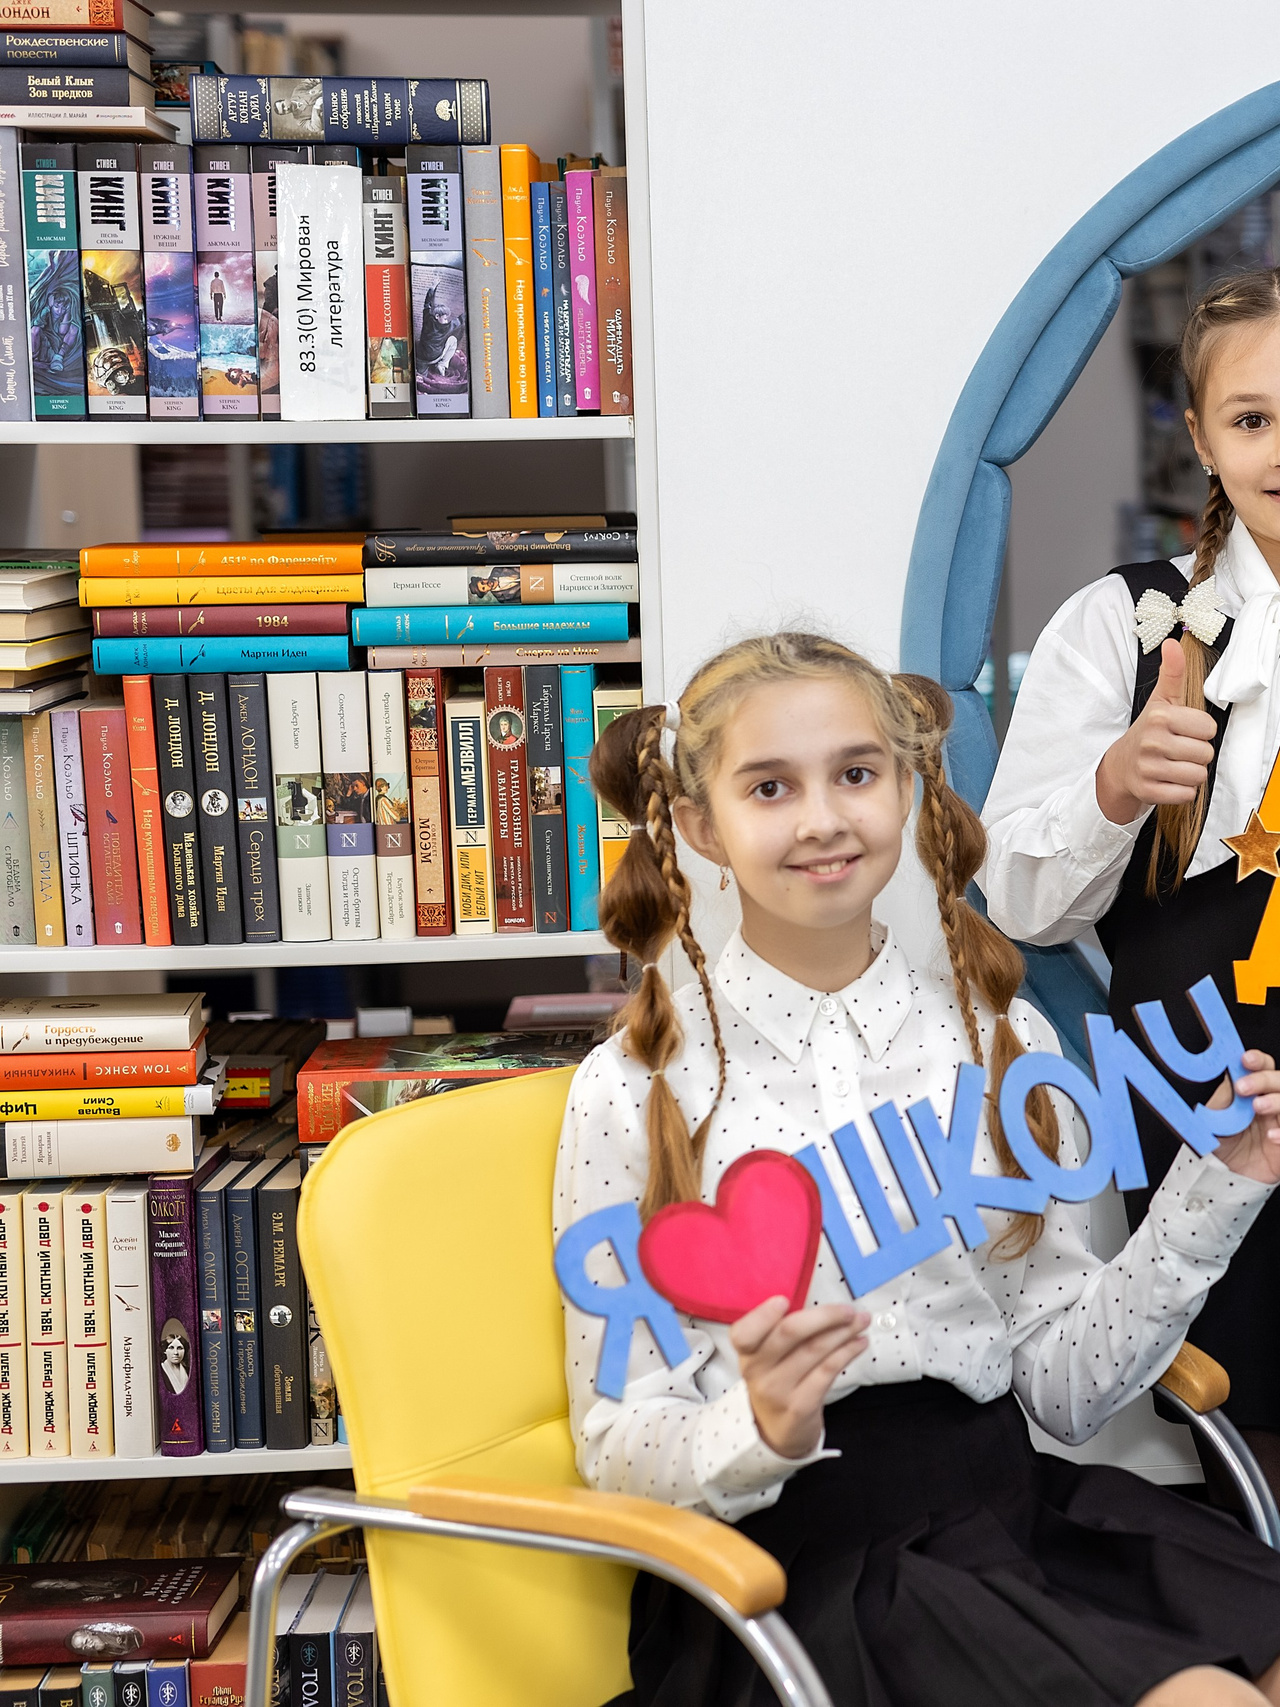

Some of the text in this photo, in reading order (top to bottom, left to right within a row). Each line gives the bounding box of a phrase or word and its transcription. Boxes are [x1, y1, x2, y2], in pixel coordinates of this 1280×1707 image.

[0, 7, 50, 19] ОНДОН
[6, 35, 109, 47] Рождественские
[7, 50, 57, 59] повести
[27, 75, 94, 86] Белый Клык
[29, 87, 93, 100] Зов предков
[228, 92, 238, 122] АРТУР
[239, 90, 249, 124] КОНАН
[250, 93, 261, 120] ДОЙЛ
[329, 91, 339, 126] Полное
[340, 88, 348, 129] собрание
[36, 159, 57, 168] СТИВЕН
[96, 159, 117, 168] СТИВЕН
[35, 174, 66, 228] КИНГ
[90, 176, 126, 231] КИНГ
[151, 177, 181, 231] КИНГ
[206, 177, 237, 232] КИНГ
[373, 208, 395, 259] КИНГ
[536, 197, 548, 270] Пауло Коэльо
[574, 188, 587, 261] Пауло Коэльо
[296, 215, 318, 373] 83.3(0) Мировая
[326, 240, 343, 348] литература
[384, 268, 392, 334] БЕССОННИЦА
[605, 318, 618, 365] МИНУТ
[614, 308, 624, 376] ОДИННАДЦАТЬ
[220, 555, 337, 569] 451° по Фаренгейту
[495, 542, 571, 552] Владимир Набоков
[392, 581, 441, 590] Герман Гессе
[569, 574, 623, 582] Степной волк
[256, 615, 289, 627] 1984
[493, 620, 591, 632] Большие надежды
[240, 647, 307, 659] Мартин Иден
[164, 698, 184, 768] Д. ЛОНДОН
[198, 690, 219, 773] Д. ЛОНДОН
[291, 700, 299, 728] Альбер
[338, 693, 346, 728] Сомерсет
[241, 725, 259, 790] ЛОНДОН
[458, 722, 477, 824] ГЕРМАН МЕЛВИЛЛ
[497, 769, 509, 839] АВАНТЮРЫ
[510, 759, 523, 849] ГРАНДИОЗНЫЕ
[418, 818, 431, 864] МОЭМ
[38, 850, 53, 903] БРИДА
[66, 832, 82, 905] ШПИОНКА
[110, 832, 123, 905] ПОБЕДИТЕЛЬ
[140, 809, 161, 936] Над кукушкиным гнездом
[172, 842, 186, 919] Большого дома
[183, 832, 199, 929] Маленькая хозяйка
[213, 845, 228, 912] Мартин Иден
[248, 830, 265, 922] Сердца трех
[460, 851, 473, 917] МОБИ ДИК, ИЛИ
[474, 870, 486, 916] БЕЛЫЙ КИТ
[45, 1025, 96, 1036] Гордость
[4, 1068, 76, 1080] УНИКАЛЬНЫЙ
[95, 1064, 171, 1075] ТОМ ХЭНКС
[78, 1107, 121, 1116] Вацлав
[83, 1097, 114, 1106] Смил
[150, 1200, 186, 1217] ОЛКОТТ
[554, 975, 1256, 1400] Я ШКОЛУ
[39, 1217, 51, 1247] ДВОР
[112, 1236, 138, 1244] Джейн
[153, 1249, 188, 1258] сочинений
[155, 1241, 185, 1249] собрание
[158, 1231, 180, 1239] Малое
[271, 1212, 285, 1287] Э.М. РЕМАРК
[38, 1251, 52, 1306] СКОТНЫЙ
[234, 1250, 250, 1301] ОСТЕН
[43, 1351, 56, 1433] ДЖОРДЖ ОРУЭЛЛ
[123, 1336, 133, 1417] Мэнсфилд-парк
[208, 1341, 221, 1434] Хорошие жены
[273, 1364, 282, 1414] обетованная
[284, 1376, 294, 1402] Земля
